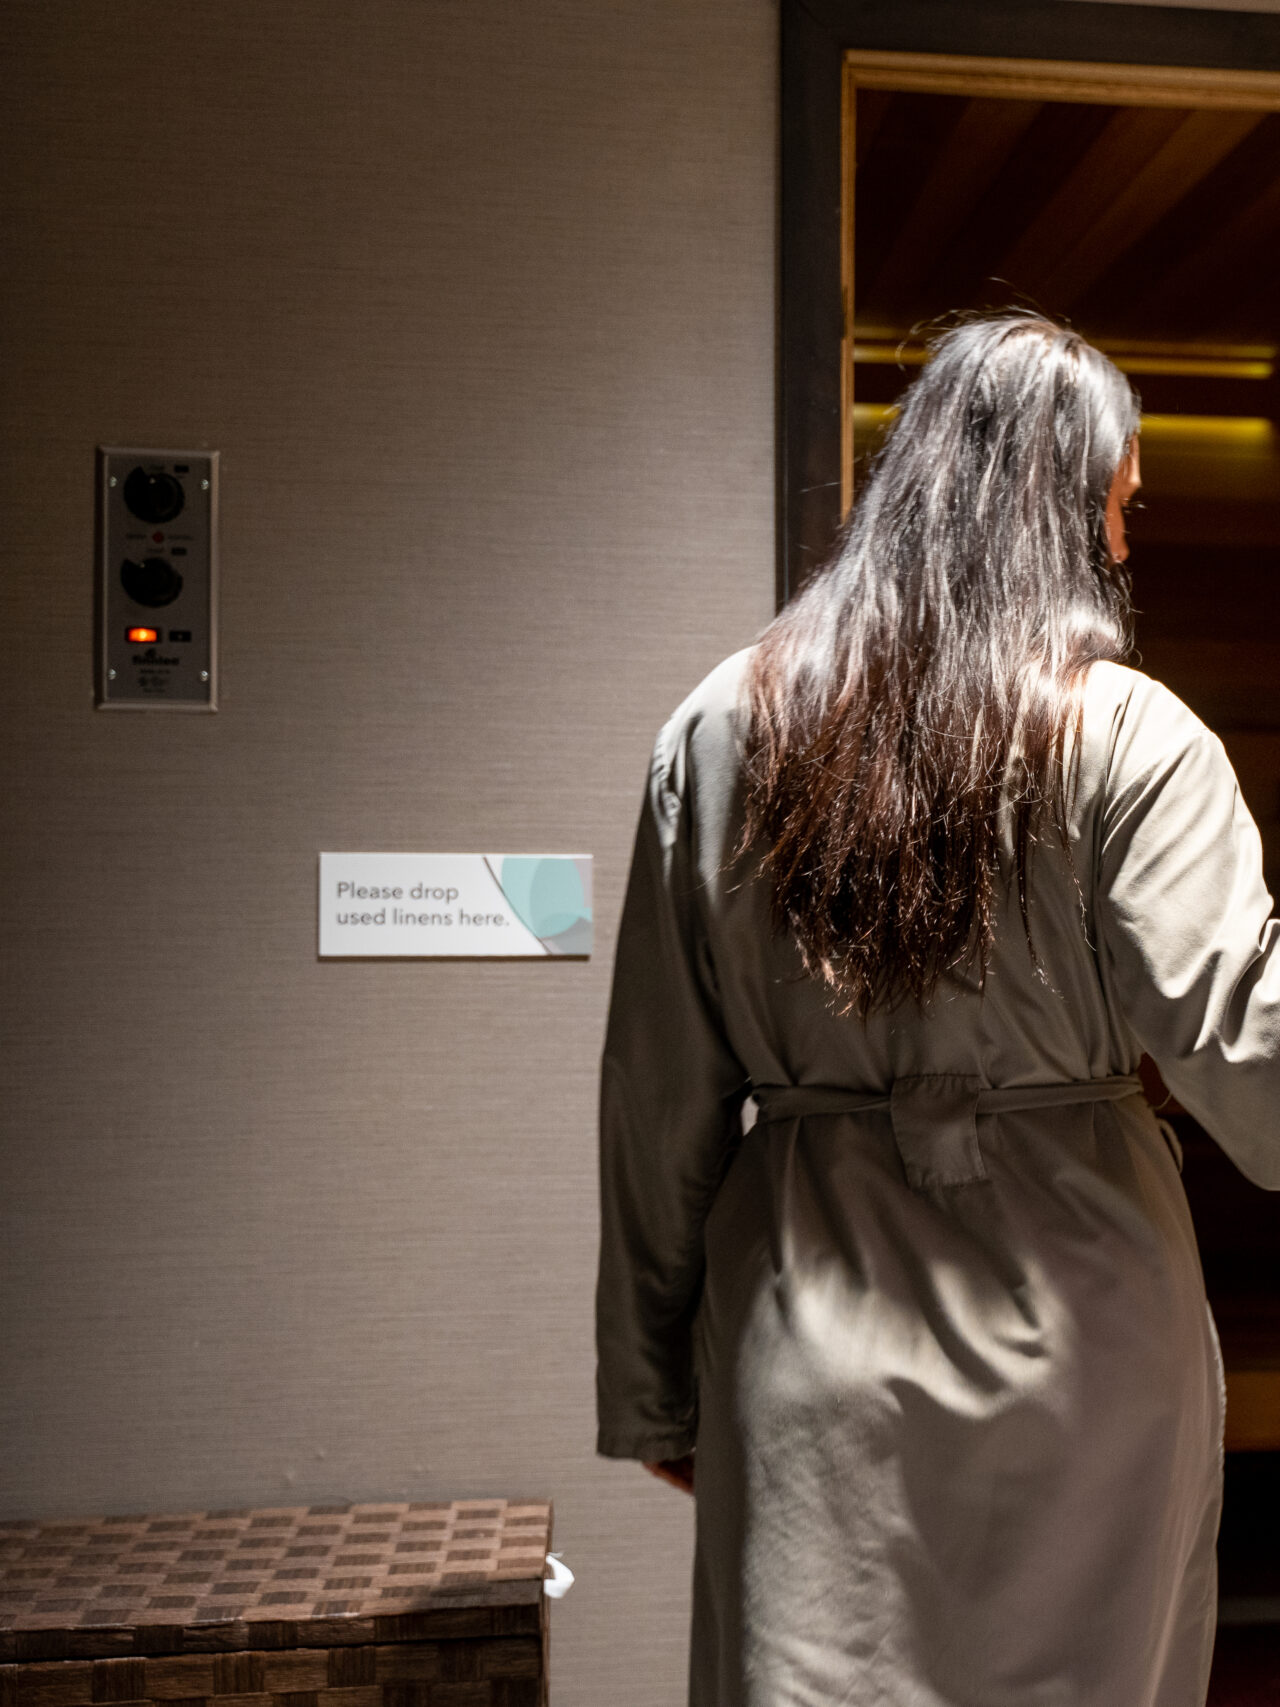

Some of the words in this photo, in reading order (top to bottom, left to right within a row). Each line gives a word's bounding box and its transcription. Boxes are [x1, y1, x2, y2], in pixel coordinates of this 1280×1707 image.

[336, 881, 404, 899] Please
[410, 883, 459, 902] drop
[336, 908, 386, 925] used
[393, 908, 453, 926] linens
[459, 909, 510, 926] here.
